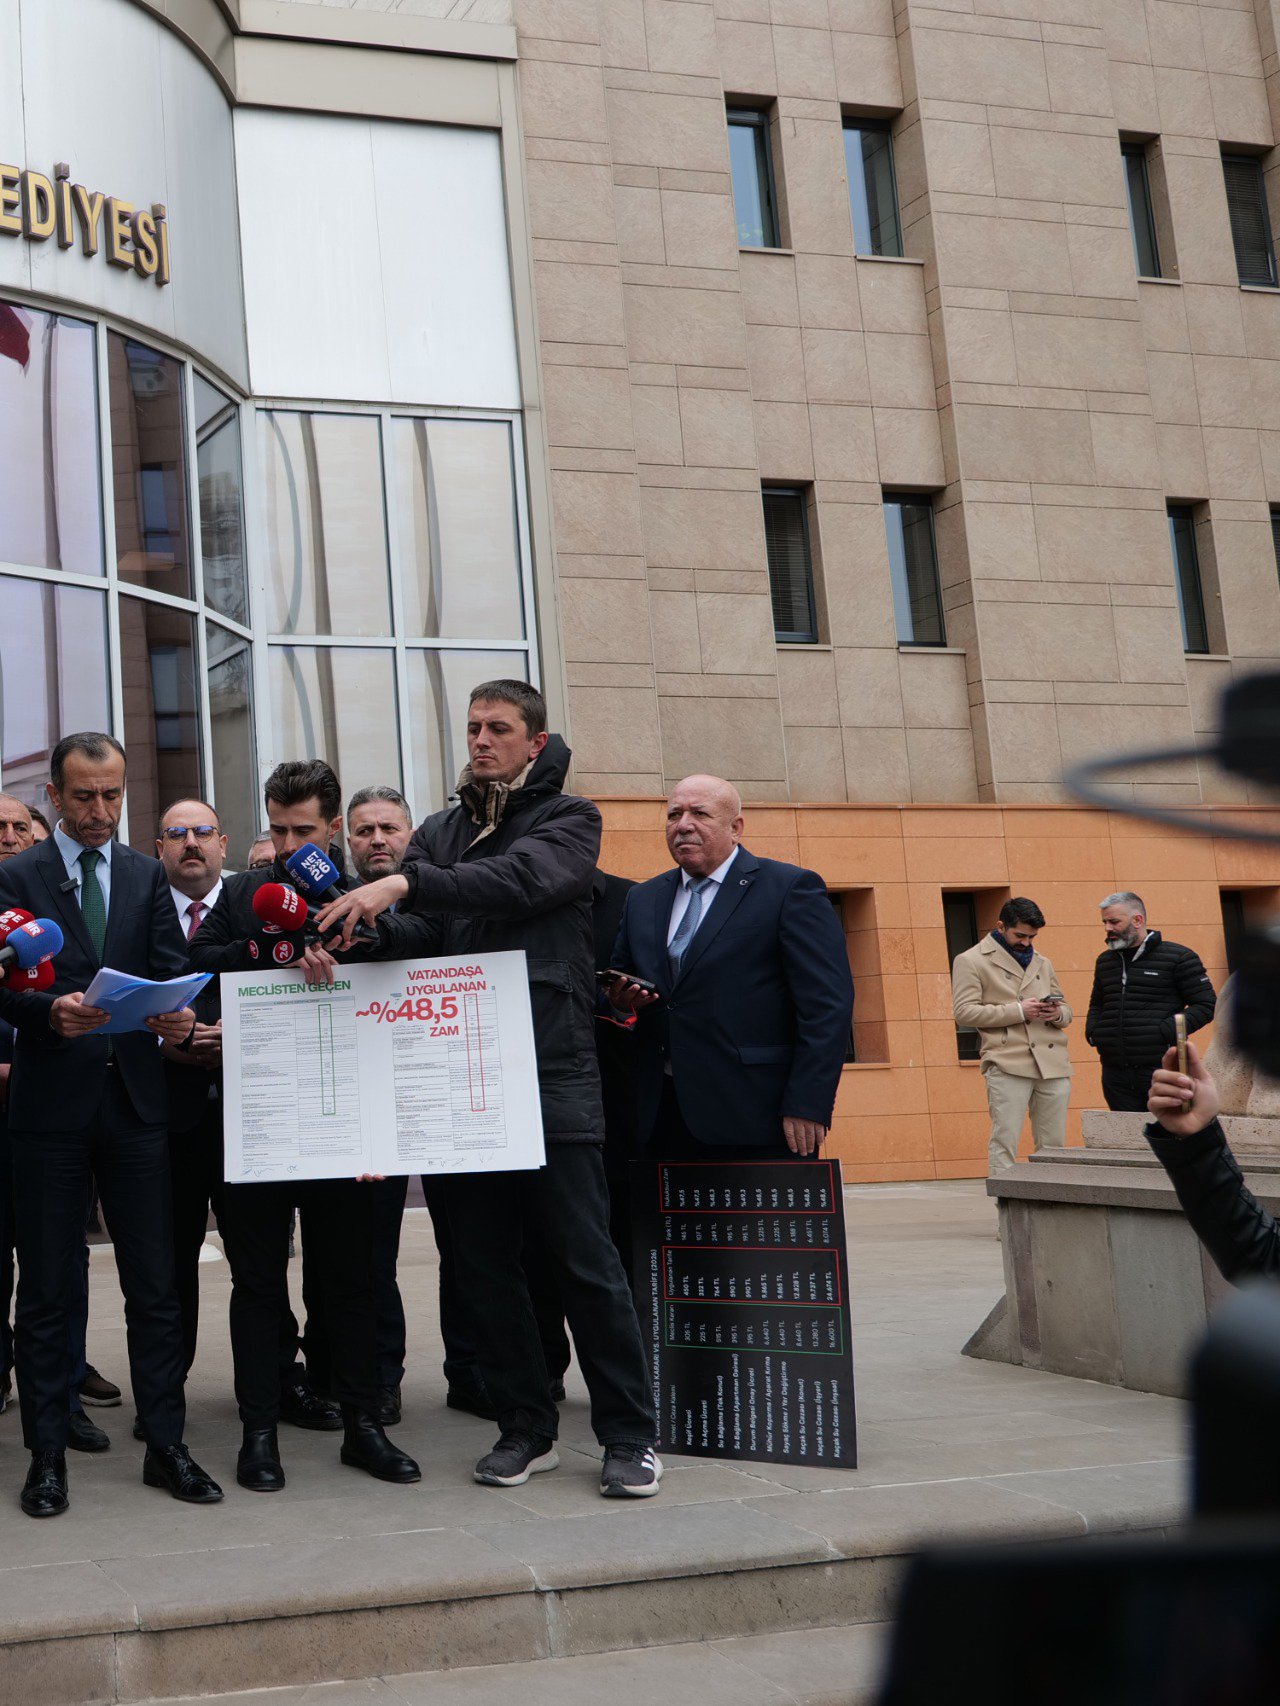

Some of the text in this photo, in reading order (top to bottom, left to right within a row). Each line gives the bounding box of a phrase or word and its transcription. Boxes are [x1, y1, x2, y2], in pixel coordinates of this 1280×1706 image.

[301, 851, 320, 869] NET
[279, 943, 289, 959] 26
[407, 965, 484, 981] VATANDAŞA
[238, 980, 351, 997] MECLİSTEN GEÇEN
[406, 980, 487, 996] UYGULANAN
[429, 1025, 460, 1037] ZAM
